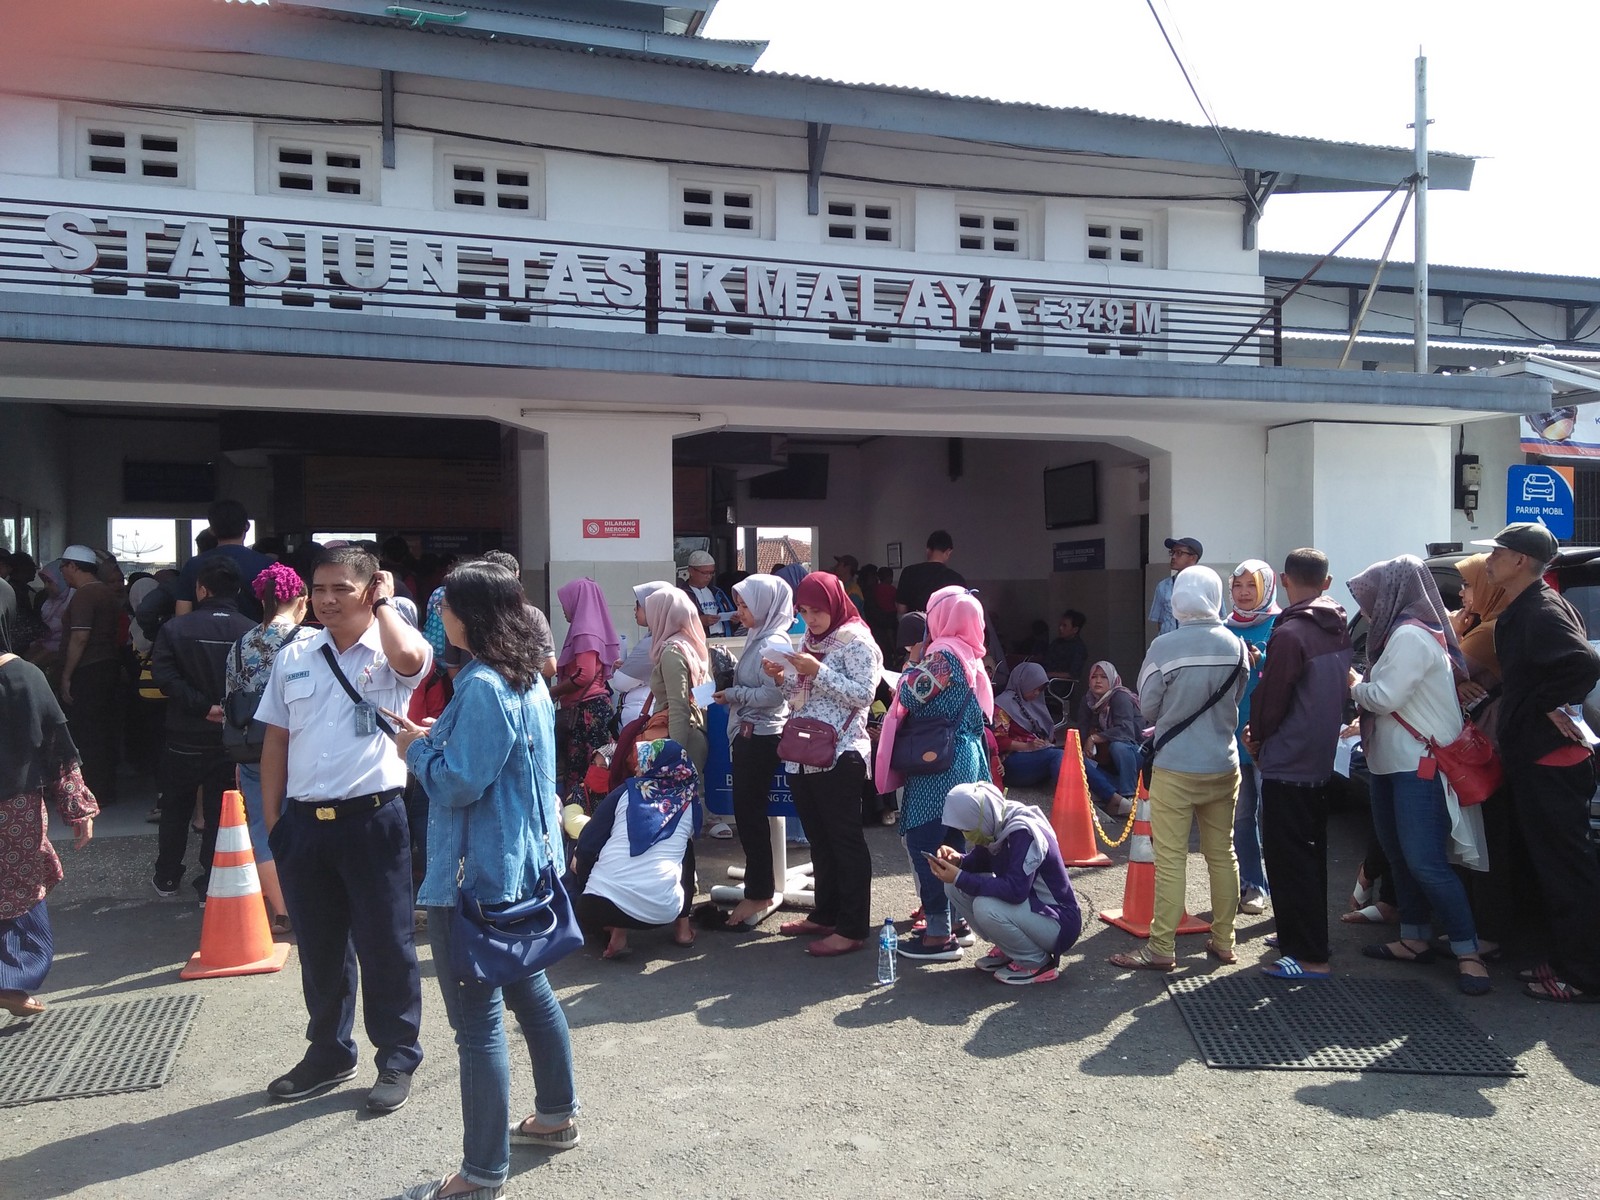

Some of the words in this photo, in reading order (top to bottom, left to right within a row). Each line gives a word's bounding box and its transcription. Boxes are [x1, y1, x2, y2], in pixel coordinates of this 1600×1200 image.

[41, 211, 459, 292] STASIUN
[491, 245, 1024, 331] TASIKMALAYA
[1134, 301, 1161, 334] M
[1515, 506, 1540, 515] PARKIR
[1542, 507, 1564, 516] MOBIL
[774, 775, 790, 788] TU
[768, 794, 780, 802] NG
[782, 794, 794, 803] ZO
